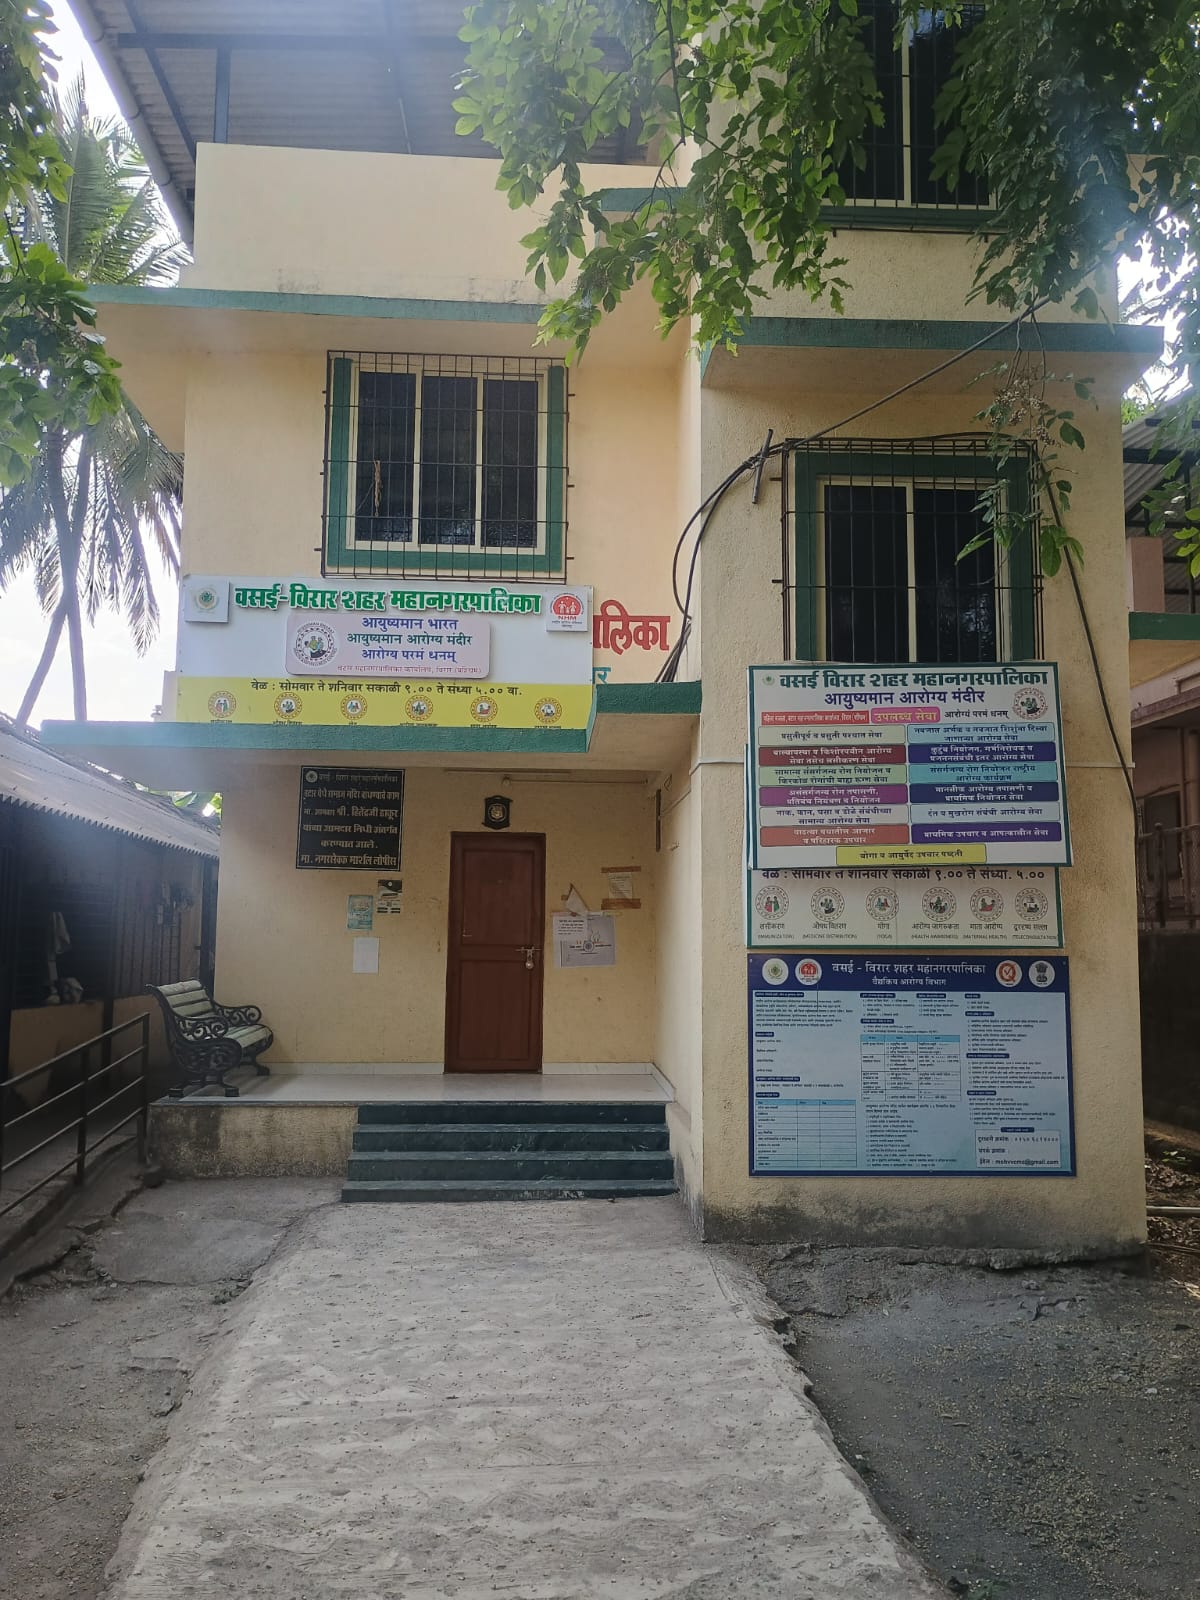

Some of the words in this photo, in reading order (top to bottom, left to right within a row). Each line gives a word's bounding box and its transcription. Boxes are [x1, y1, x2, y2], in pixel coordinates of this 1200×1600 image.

[235, 583, 338, 610] वसई-विरार
[341, 586, 386, 612] शहर
[389, 586, 542, 615] महानगरपालिका
[362, 617, 423, 633] आयुष्यमान
[427, 617, 458, 630] भारत
[347, 633, 402, 647] आयुष्यमान
[406, 633, 443, 646] आरोग्य
[446, 633, 472, 646] मंदीर
[361, 647, 398, 660] आरोग्य
[401, 647, 424, 660] परमं
[428, 649, 458, 663] धनम्
[779, 671, 818, 688] वसई
[823, 670, 865, 688] विरार
[870, 671, 908, 687] शहर
[912, 667, 1048, 687] महानगरपालिका
[251, 679, 268, 691] वेळ
[279, 679, 314, 692] सोमवार
[318, 679, 325, 692] ते
[328, 680, 363, 692] शनिवार
[366, 681, 400, 694] सकाळी
[436, 682, 444, 695] ते
[447, 682, 472, 695] संध्या
[824, 690, 895, 710] आयुष्यमान
[899, 688, 947, 705] आरोग्य
[951, 688, 985, 704] मंदीर
[874, 710, 913, 723] उपलब्ध
[915, 709, 938, 721] सेवा
[990, 710, 1010, 719] धनम्
[868, 730, 882, 738] सेवा
[977, 733, 1002, 741] आरोग्य
[1004, 733, 1018, 741] सेवा
[866, 745, 892, 754] आरोग्य
[789, 756, 804, 764] सेवा
[861, 755, 876, 763] सेवा
[992, 753, 1018, 761] आरोग्य
[1020, 752, 1035, 760] सेवा
[838, 767, 852, 775] रोग
[966, 764, 979, 772] रोग
[873, 775, 888, 783] सेवा
[956, 773, 981, 781] आरोग्य
[831, 788, 845, 796] रोग
[967, 784, 994, 792] आरोग्य
[1008, 792, 1024, 800] सेवा
[999, 807, 1026, 815] आरोग्य
[1028, 806, 1043, 815] सेवा
[827, 816, 854, 824] आरोग्य
[855, 816, 871, 824] सेवा
[1033, 827, 1049, 835] सेवा
[967, 867, 976, 879] ते
[911, 921, 931, 930] आरोग्य
[984, 922, 1003, 930] आरोग्य
[831, 960, 855, 975] वसई
[865, 960, 891, 974] विरार
[893, 962, 913, 974] शहर
[916, 960, 986, 975] महानगरपालिका
[900, 976, 924, 985] आरोग्य
[925, 976, 947, 985] विभाग
